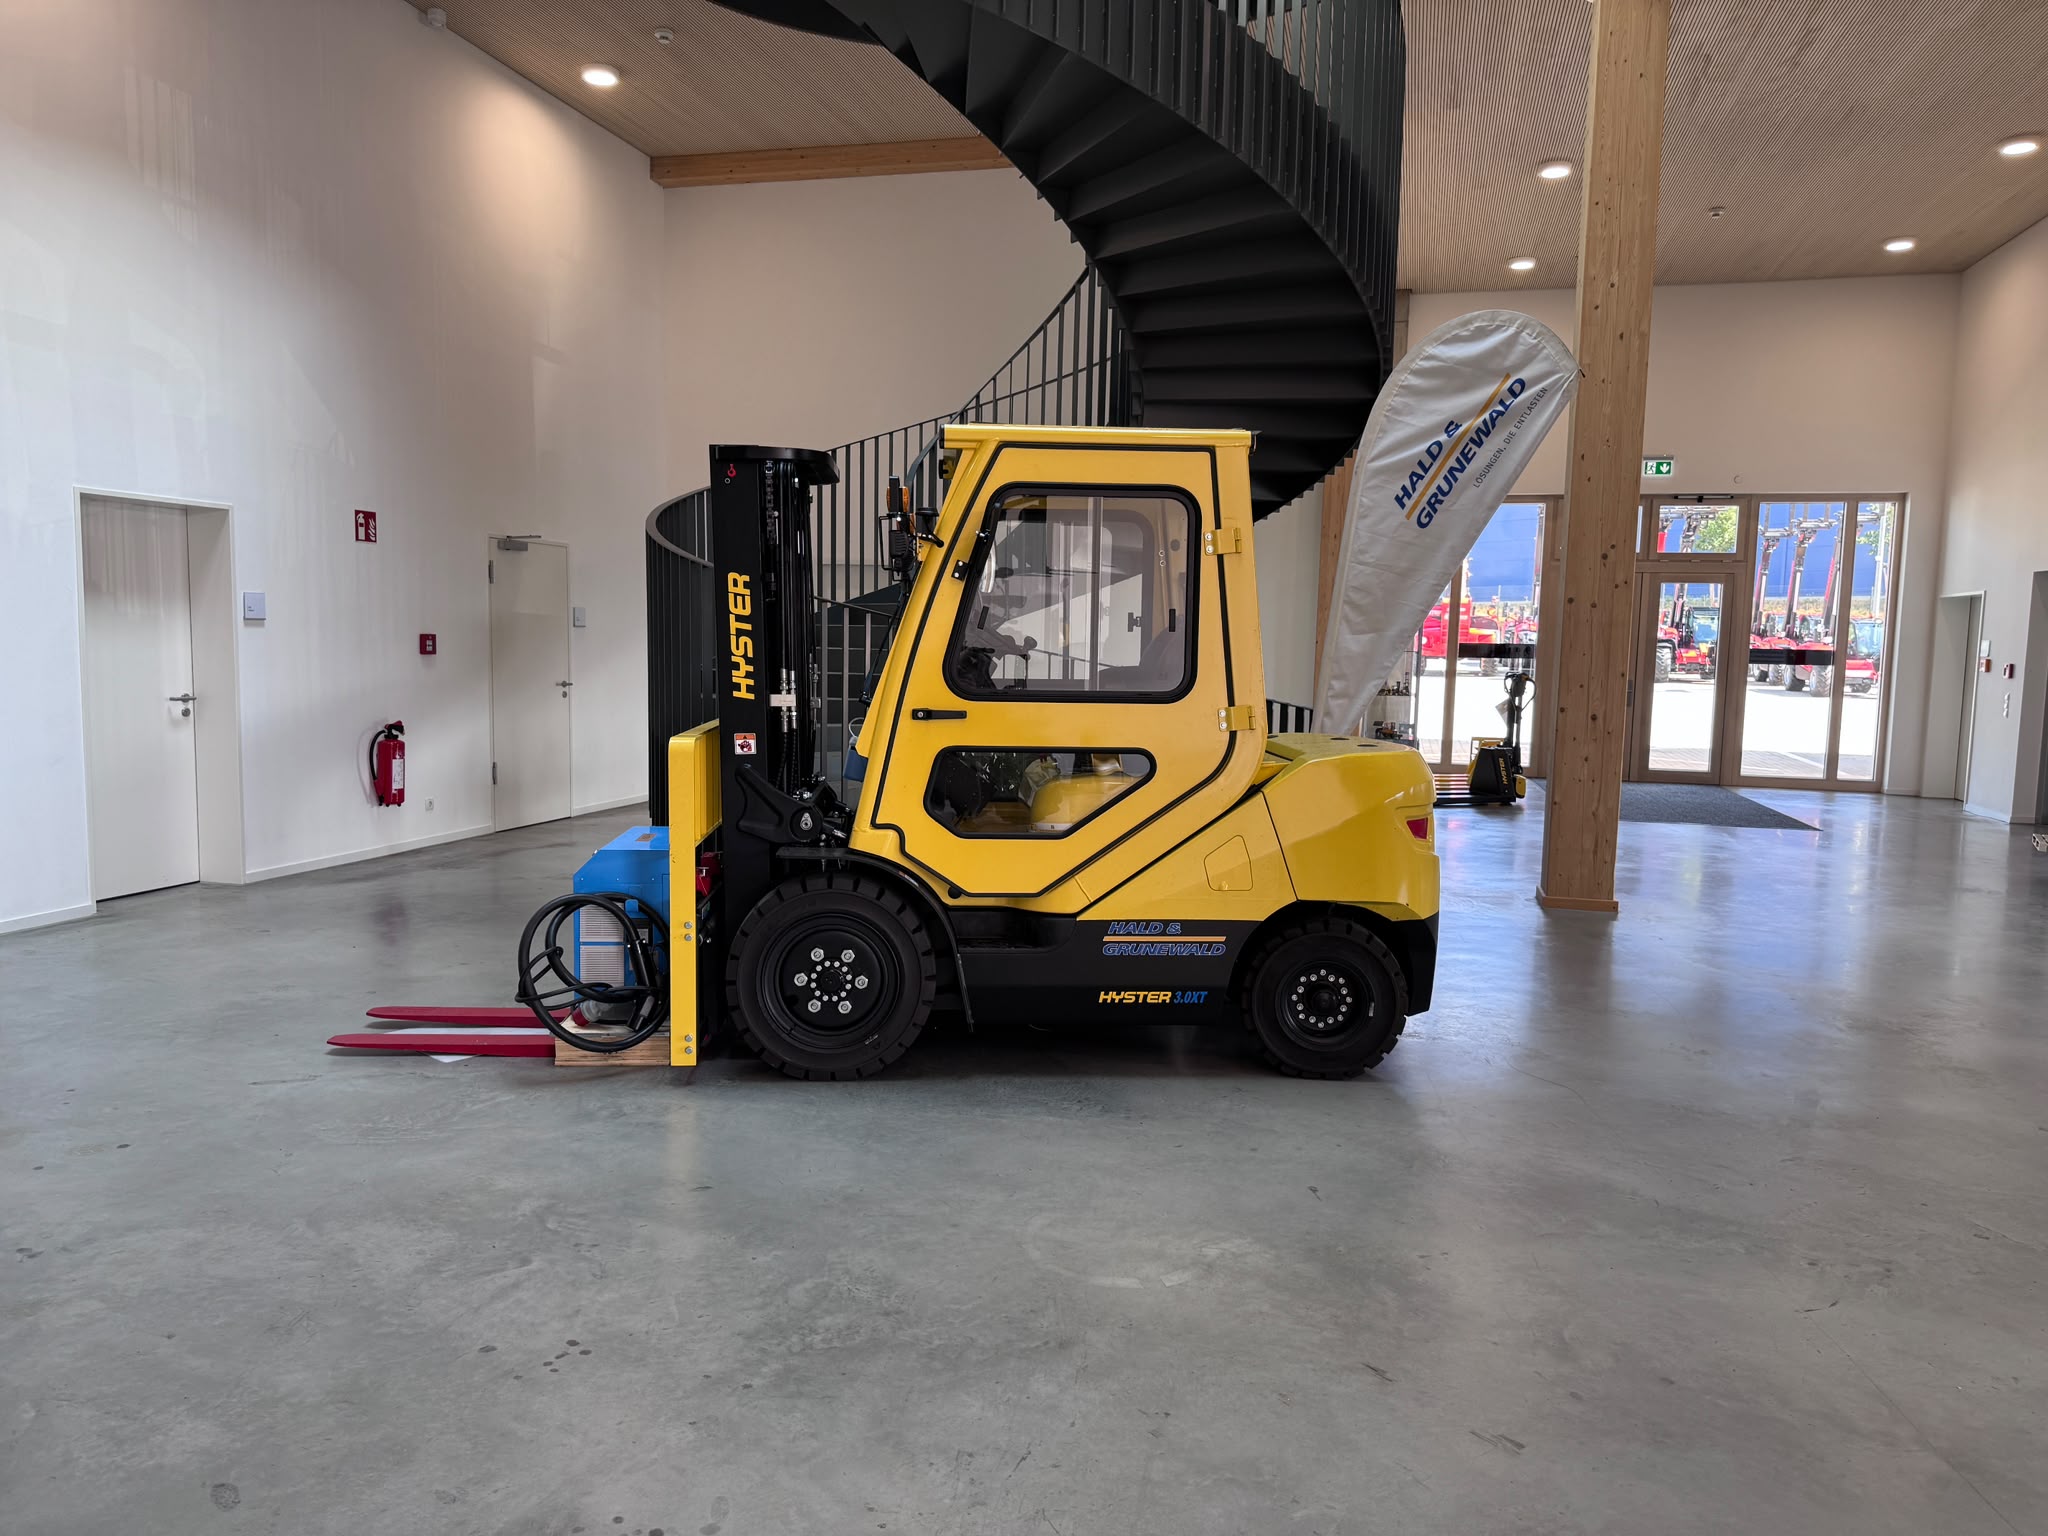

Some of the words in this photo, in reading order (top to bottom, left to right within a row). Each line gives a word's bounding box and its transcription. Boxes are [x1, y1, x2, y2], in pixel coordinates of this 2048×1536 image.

[1503, 430, 1517, 445] DIE
[1513, 387, 1548, 430] ENTLASTEN
[1394, 439, 1444, 511] HALD
[1443, 419, 1463, 439] &
[1416, 377, 1527, 529] GRUNEWALD
[727, 571, 755, 701] HYSTER
[1102, 943, 1226, 956] GRUNEWALD
[1107, 922, 1164, 935] HALD
[1165, 922, 1182, 935] &
[1098, 991, 1172, 1004] HYSTER
[1173, 991, 1208, 1004] 3.0XT
